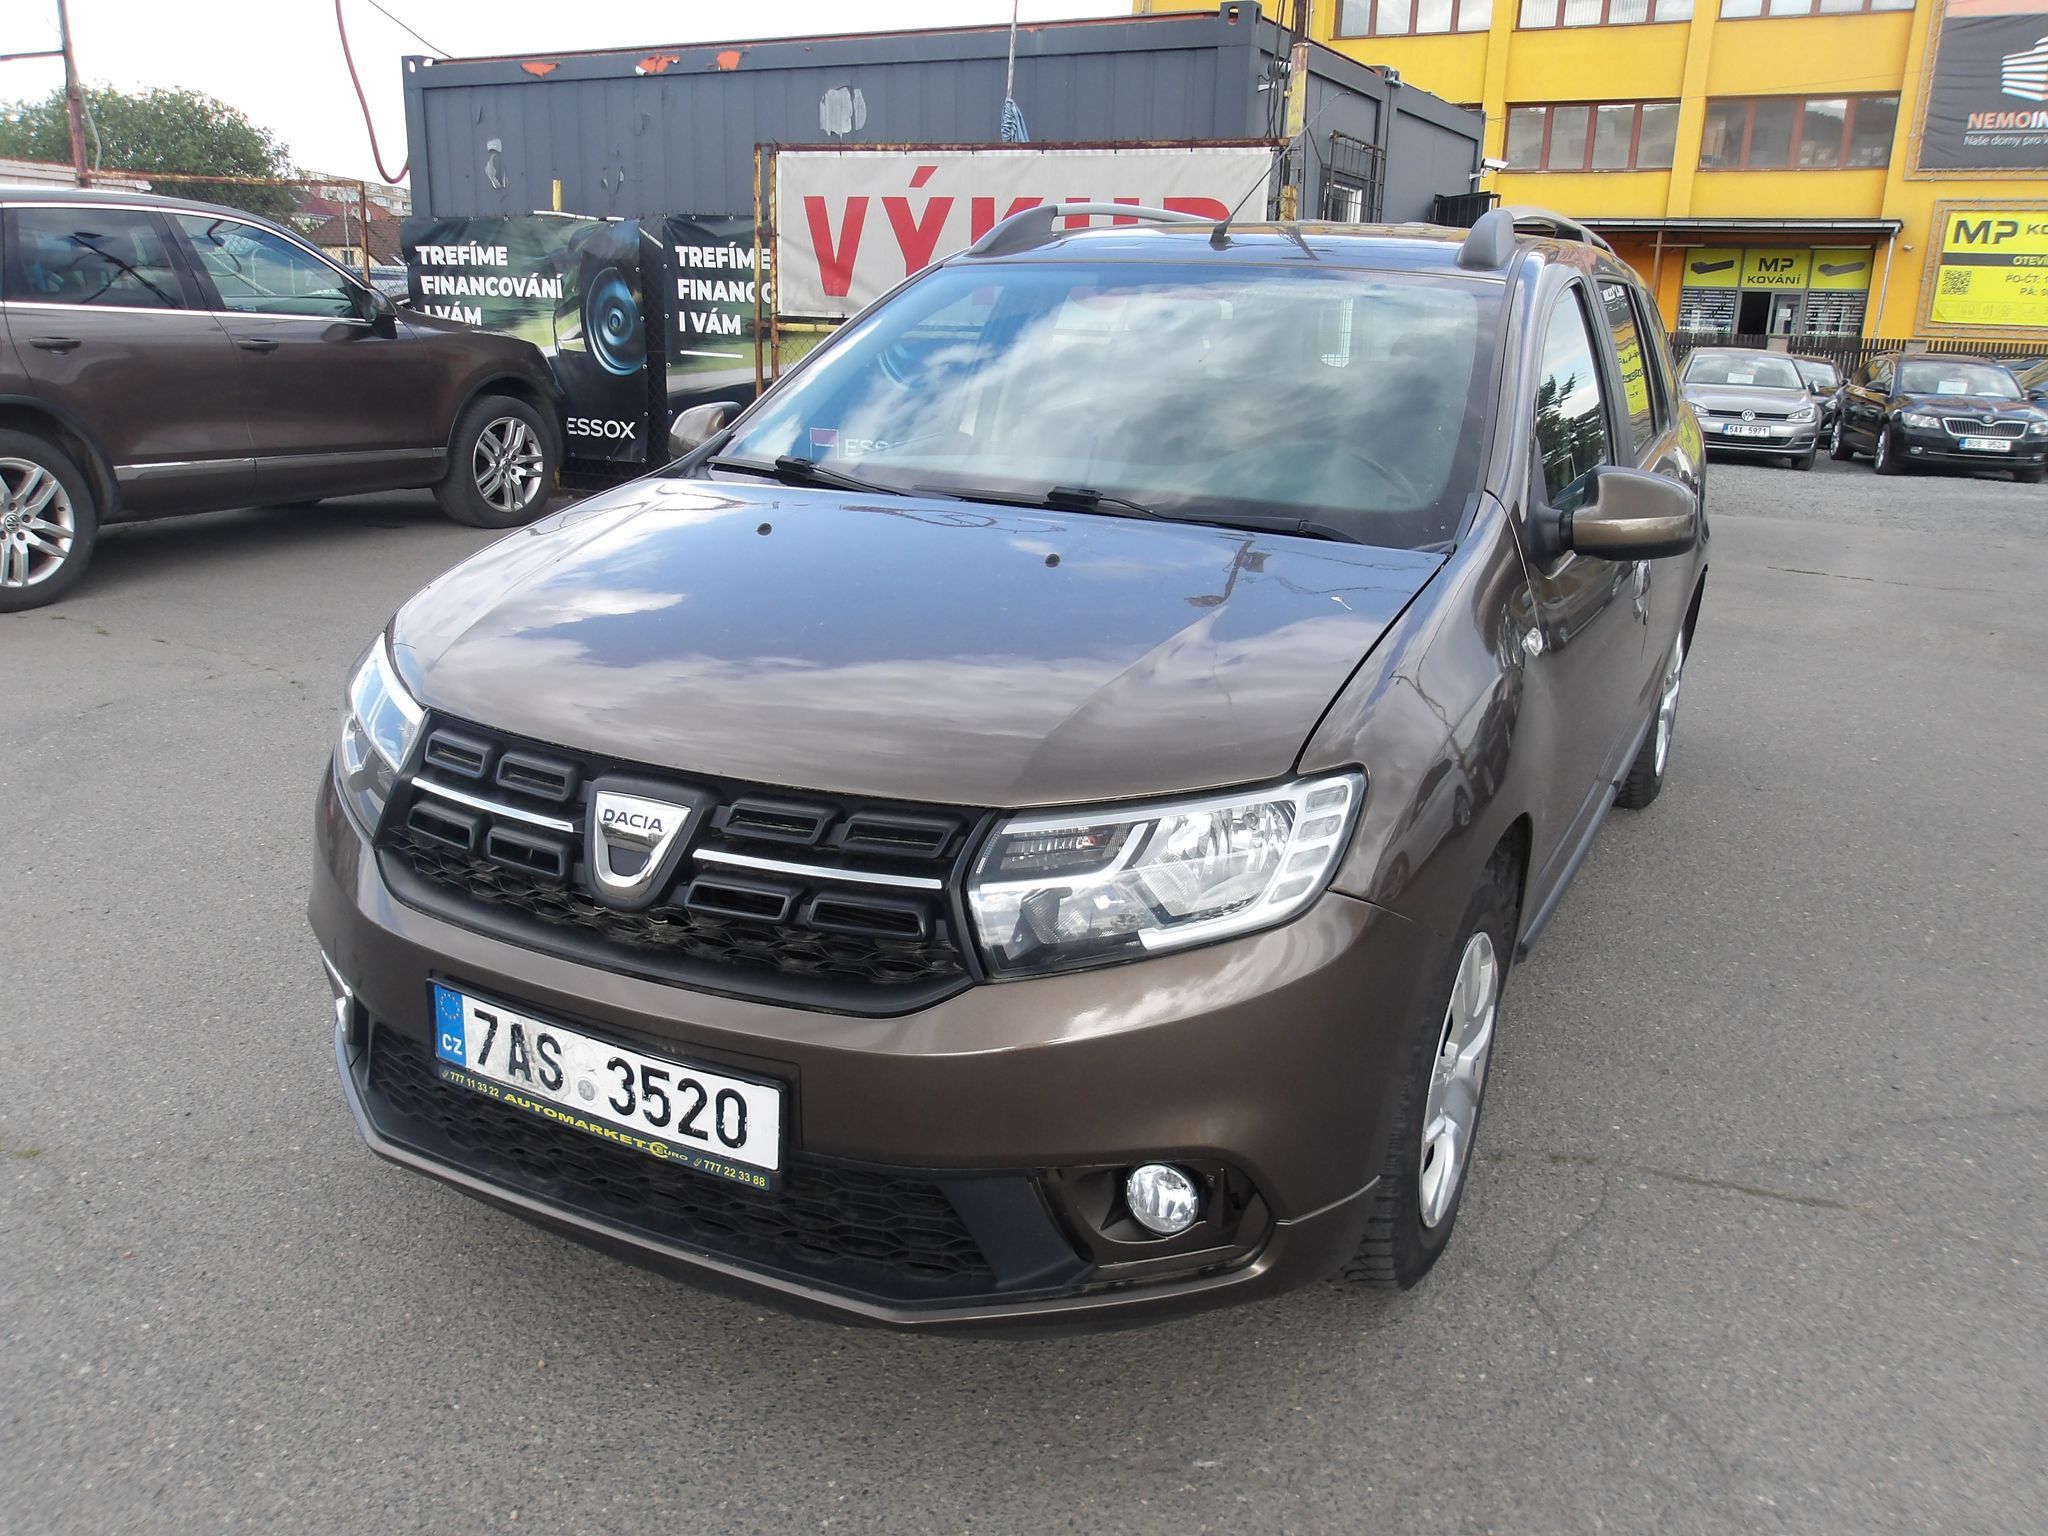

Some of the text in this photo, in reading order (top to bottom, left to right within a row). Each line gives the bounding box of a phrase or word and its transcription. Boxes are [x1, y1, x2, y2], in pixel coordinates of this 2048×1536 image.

[1952, 219, 2019, 245] MP
[415, 240, 508, 267] TREFÍME
[674, 241, 771, 270] TREFÍME
[1758, 257, 1794, 273] MP
[420, 272, 563, 299] FINANCOVÁNÍ
[1747, 274, 1801, 285] KOVÁNÍ
[434, 301, 482, 327] VÁM
[678, 307, 742, 335] I VÁM
[566, 417, 636, 440] ESSOX
[602, 808, 663, 833] DACIA
[442, 1033, 463, 1056] CZ
[450, 1071, 500, 1097] 777 11 33 22
[473, 1007, 748, 1149] 7AS 3520
[503, 1093, 646, 1149] AUTOMARKET
[704, 1159, 766, 1187] 777 22 33 88
